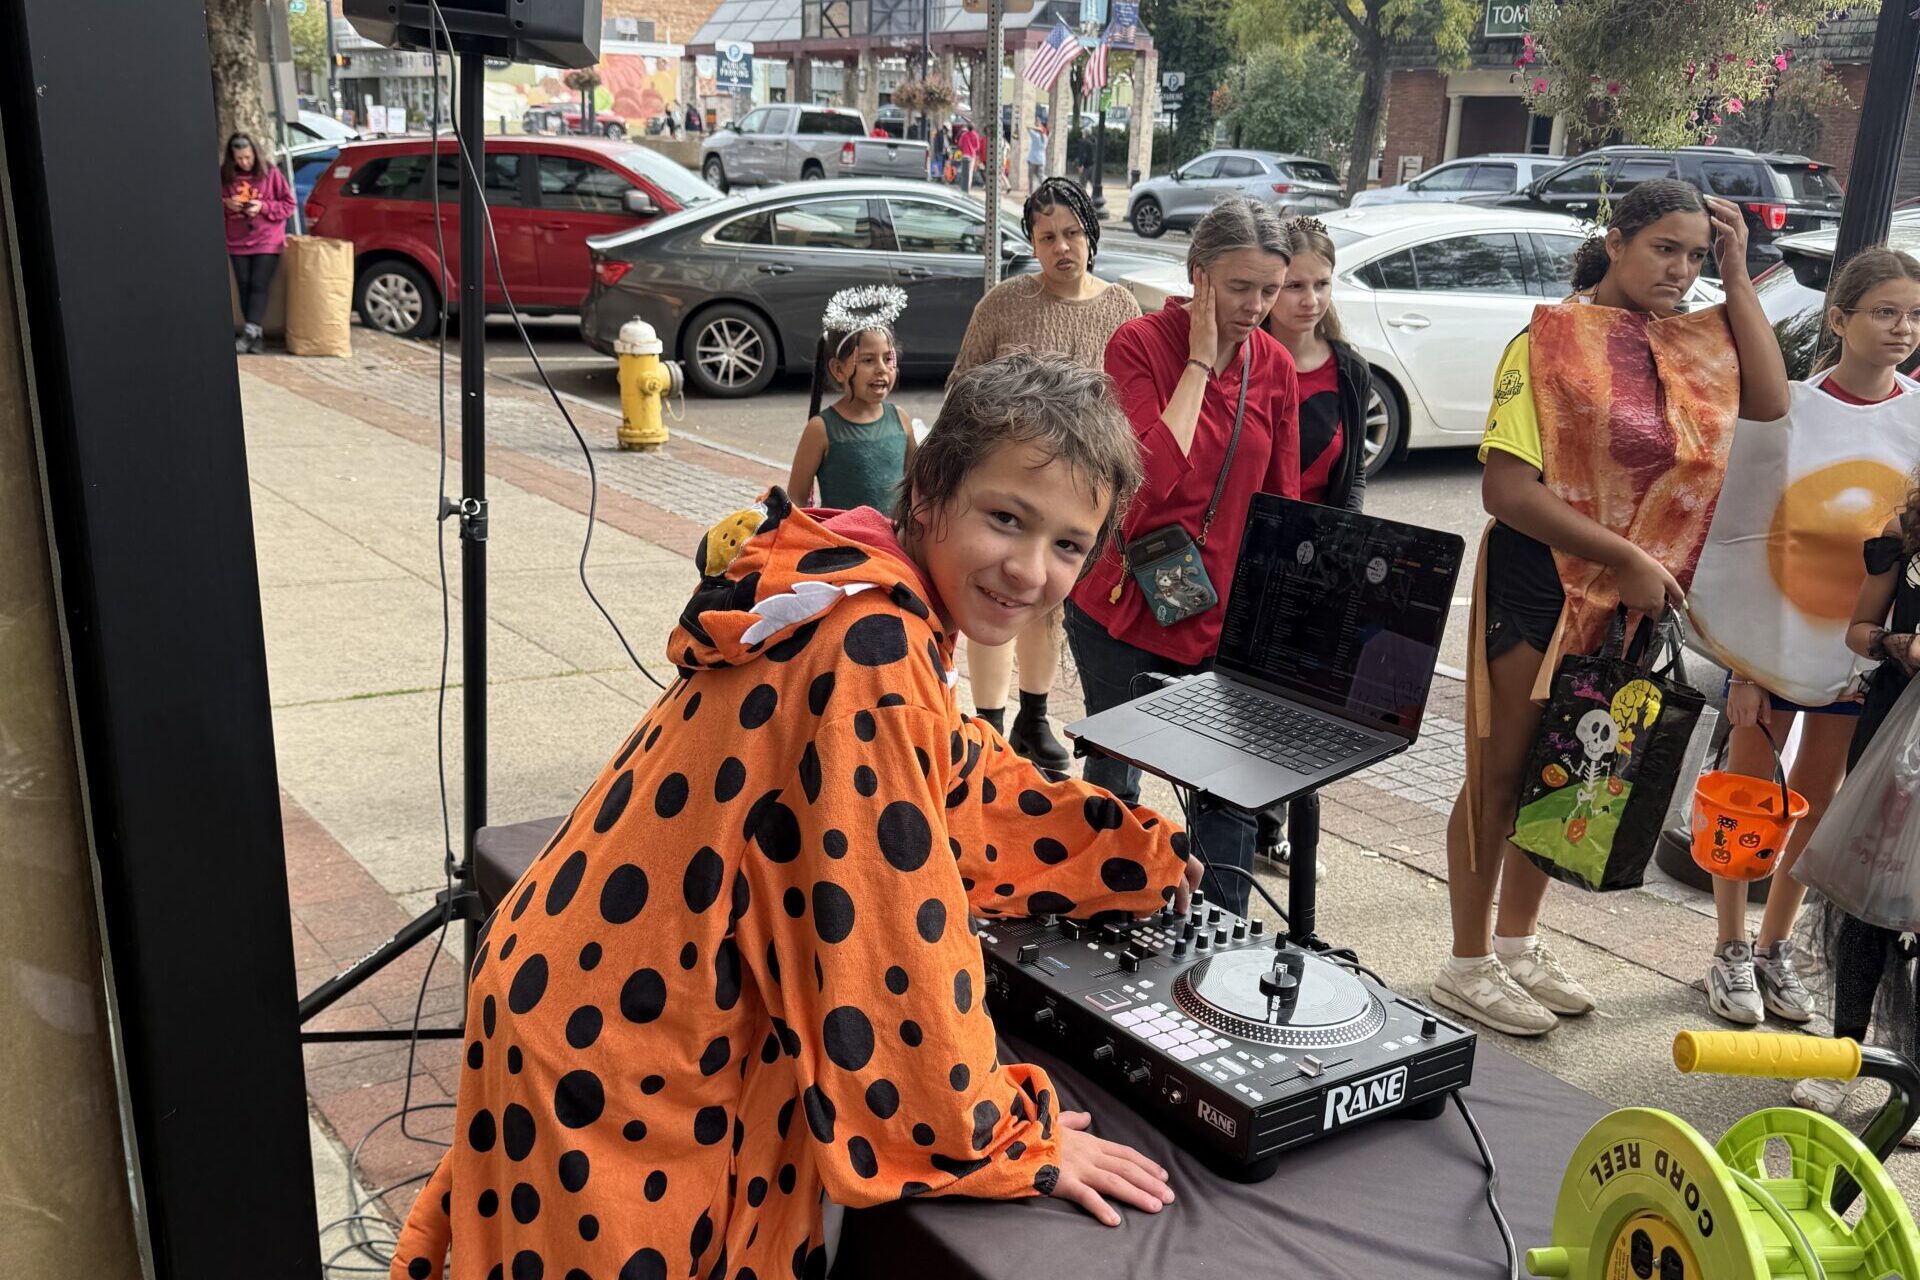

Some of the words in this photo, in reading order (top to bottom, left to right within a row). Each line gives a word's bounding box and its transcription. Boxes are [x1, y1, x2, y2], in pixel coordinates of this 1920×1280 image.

[719, 67, 750, 79] PARKING
[1197, 1099, 1237, 1138] RANE
[1322, 1066, 1408, 1131] RANE
[1589, 1142, 1641, 1187] REEL
[1654, 1149, 1714, 1238] CORD
